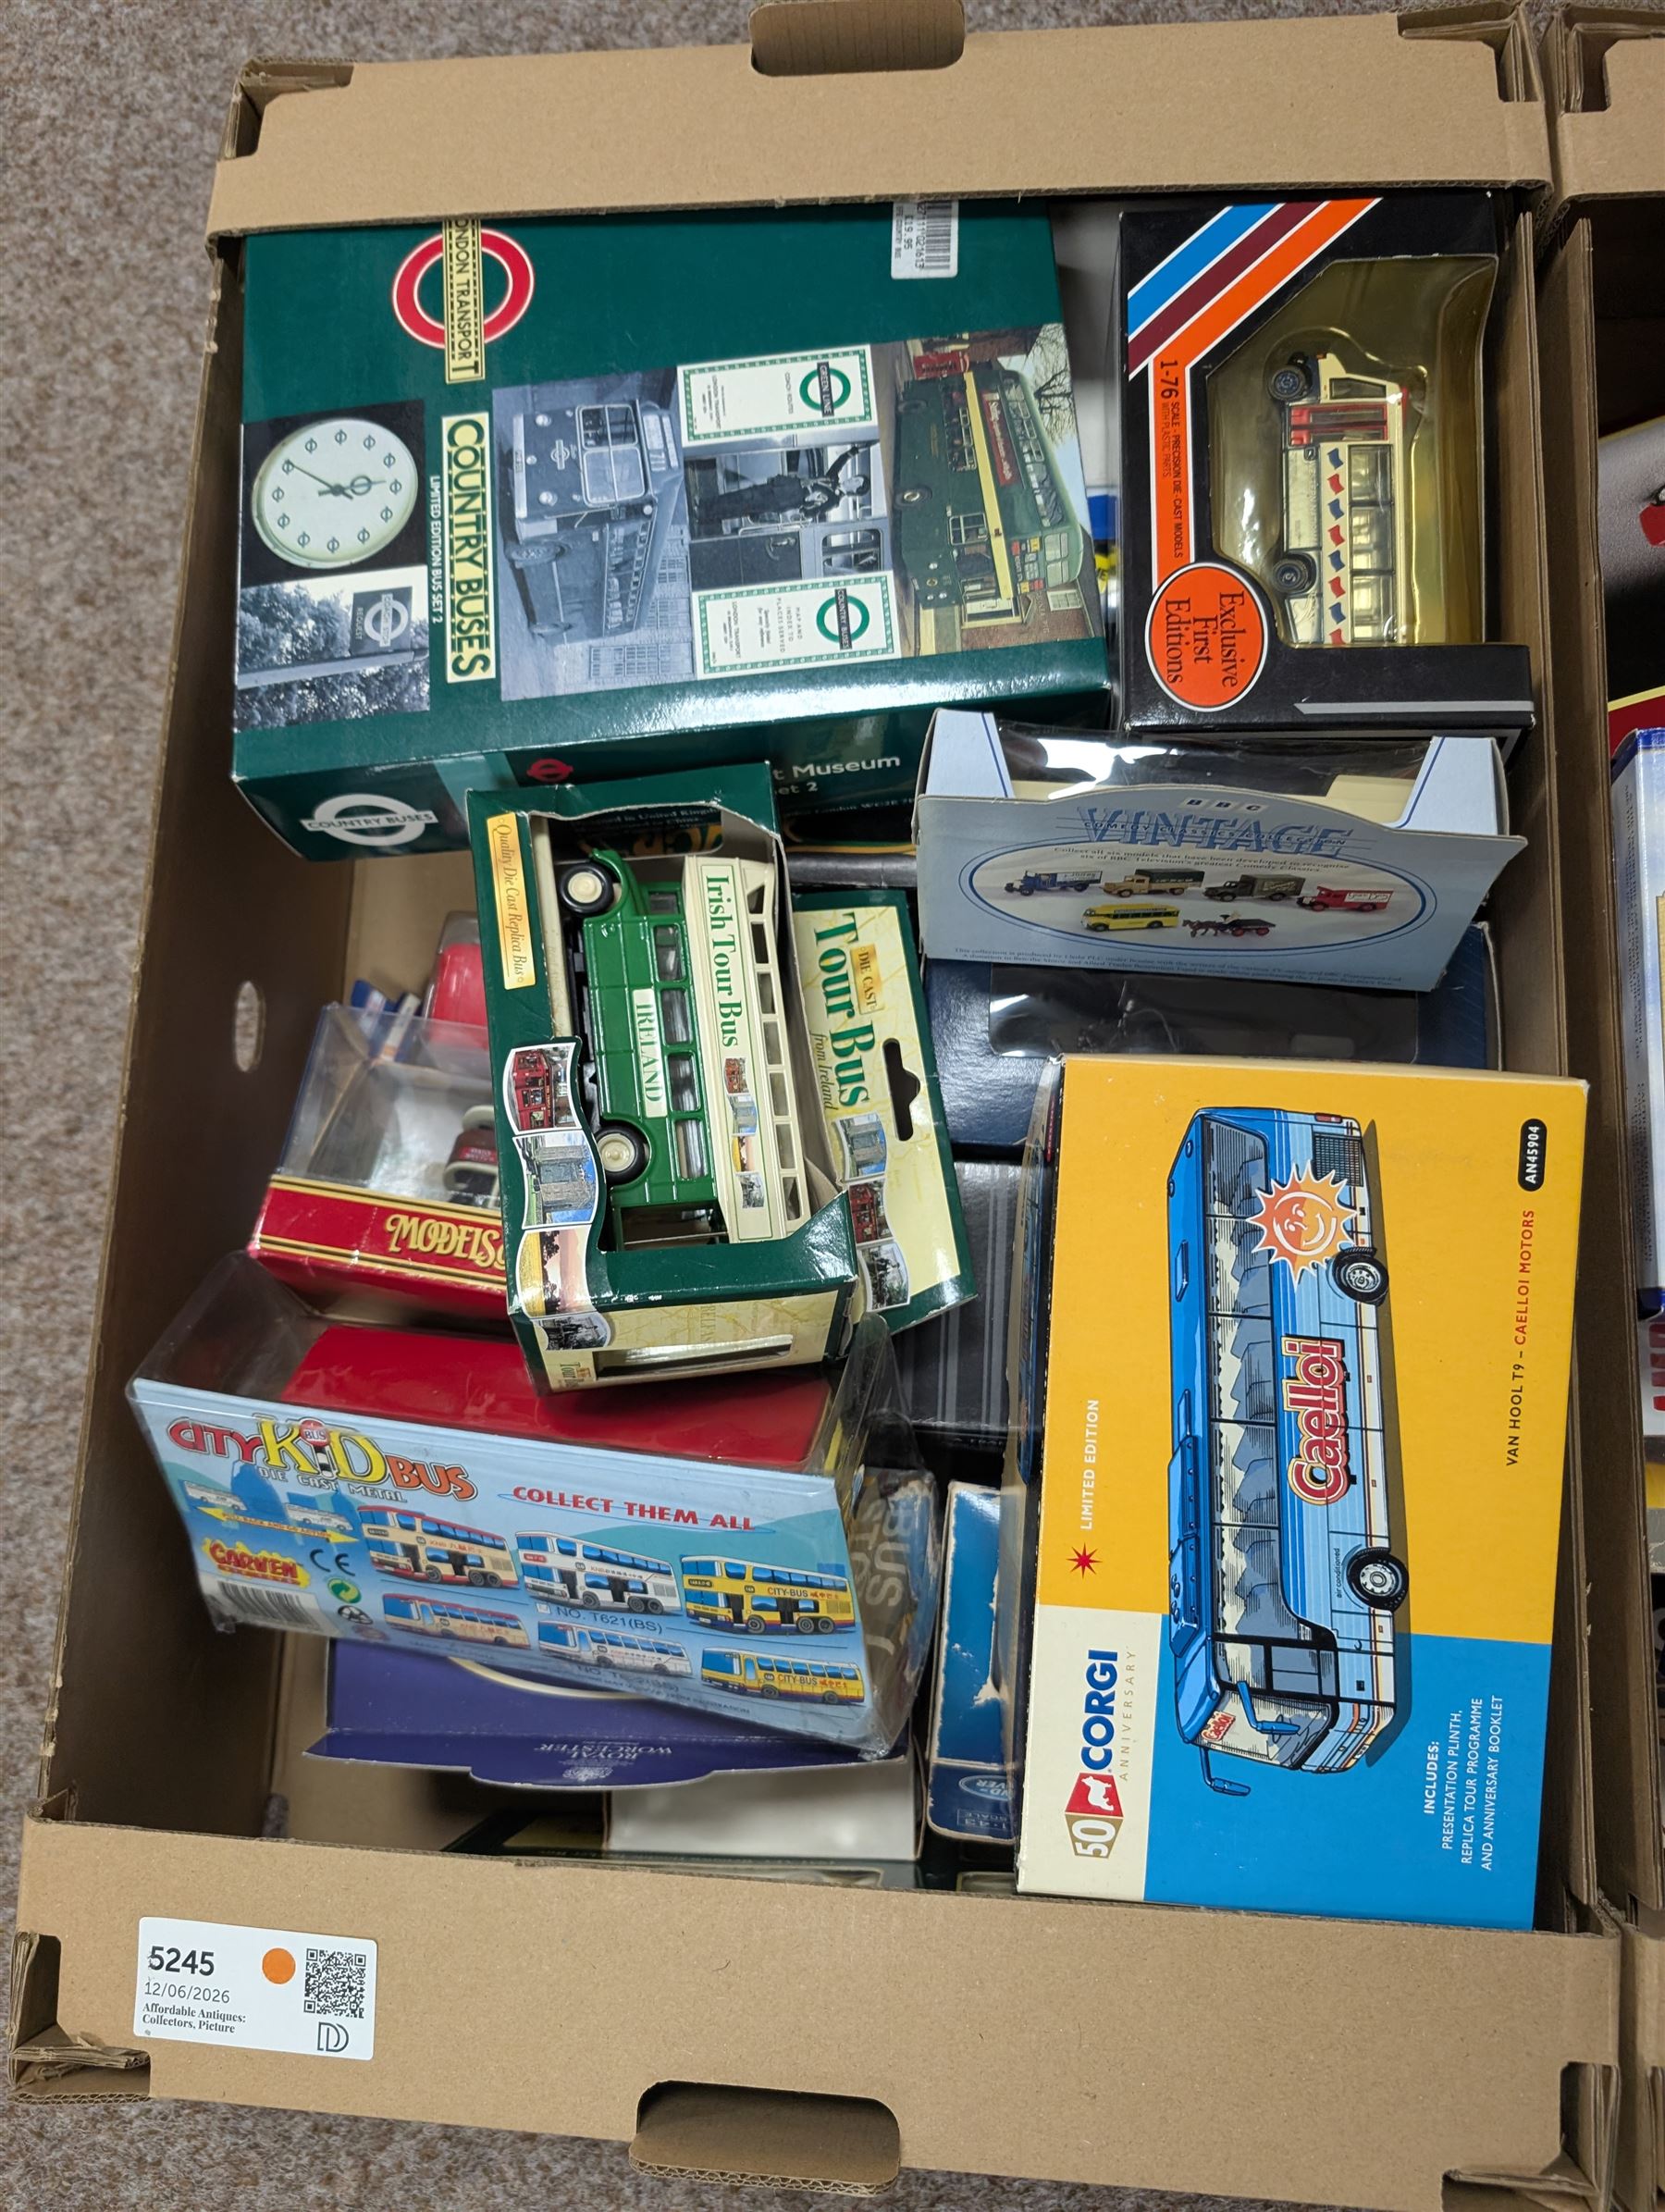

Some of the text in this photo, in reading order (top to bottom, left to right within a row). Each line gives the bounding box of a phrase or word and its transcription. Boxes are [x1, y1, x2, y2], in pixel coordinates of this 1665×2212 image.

[452, 218, 479, 374] ONDON TRANSPORT
[820, 365, 832, 414] GREEN LINE
[1160, 360, 1179, 399] 1-76
[430, 475, 441, 517] LIMITED
[1171, 402, 1183, 559] SCALE PRECISION MODELS
[431, 522, 442, 569] EDITION
[448, 419, 490, 677] COUNTRY BUSES
[432, 570, 442, 591] BUS
[432, 592, 443, 614] SET
[836, 589, 851, 649] COUNTRY BUSES
[1166, 598, 1191, 684] Editions
[1193, 614, 1218, 664] First
[1219, 591, 1246, 687] Exclusive
[773, 782, 819, 796] et 2
[792, 756, 901, 778] Museum
[307, 812, 434, 830] COUNTRY BUSES
[1084, 821, 1149, 832] COMEDY
[1185, 798, 1262, 812] BBC
[1078, 806, 1353, 858] VINTAGE
[496, 822, 527, 976] Quality Die Cast Replica Bus
[706, 875, 743, 1047] Irish Tour Bus
[858, 951, 877, 1007] DIE CAST
[814, 911, 876, 1106] Tour Bus
[635, 1004, 665, 1102] IRELAND
[810, 1031, 839, 1110] from Ireland
[1525, 1125, 1540, 1184] AN45904
[1507, 1209, 1535, 1466] VAN HOOL T9 CAELLOI MOTORS
[303, 1428, 327, 1440] BUS
[1281, 1335, 1350, 1506] Caelloi
[166, 1417, 265, 1464] CITY
[384, 1453, 479, 1501] BUS
[258, 1465, 407, 1503] DIE CAST METAL
[1080, 1399, 1099, 1530] LIMITED EDITION
[513, 1486, 757, 1531] COLLECT THEM ALL
[865, 1508, 915, 1606] BUS
[1332, 1547, 1341, 1584] conditioned
[556, 1606, 663, 1635] NO. T621(BS)
[1080, 1649, 1118, 1771] CORGI
[1119, 1650, 1137, 1781] ANNIVERSARY
[539, 1742, 672, 1755] WORCESTER
[569, 1751, 638, 1760] ROYAL
[976, 1778, 1005, 1789] VER
[1424, 1740, 1439, 1814] INCLUDES:
[1442, 1710, 1462, 1850] PRESENTATION PLINTH,
[1462, 1698, 1483, 1864] REPLICA TOUR PROGRAMME
[1481, 1695, 1503, 1871] AND ANNIVERSARY BOOKLET
[1073, 1820, 1116, 1859] 50
[148, 1946, 215, 1977] 5245
[142, 2003, 246, 2024] Affordable Antiques:
[144, 1982, 230, 2005] 12/06/2026
[142, 2014, 236, 2034] Collectors, Picture
